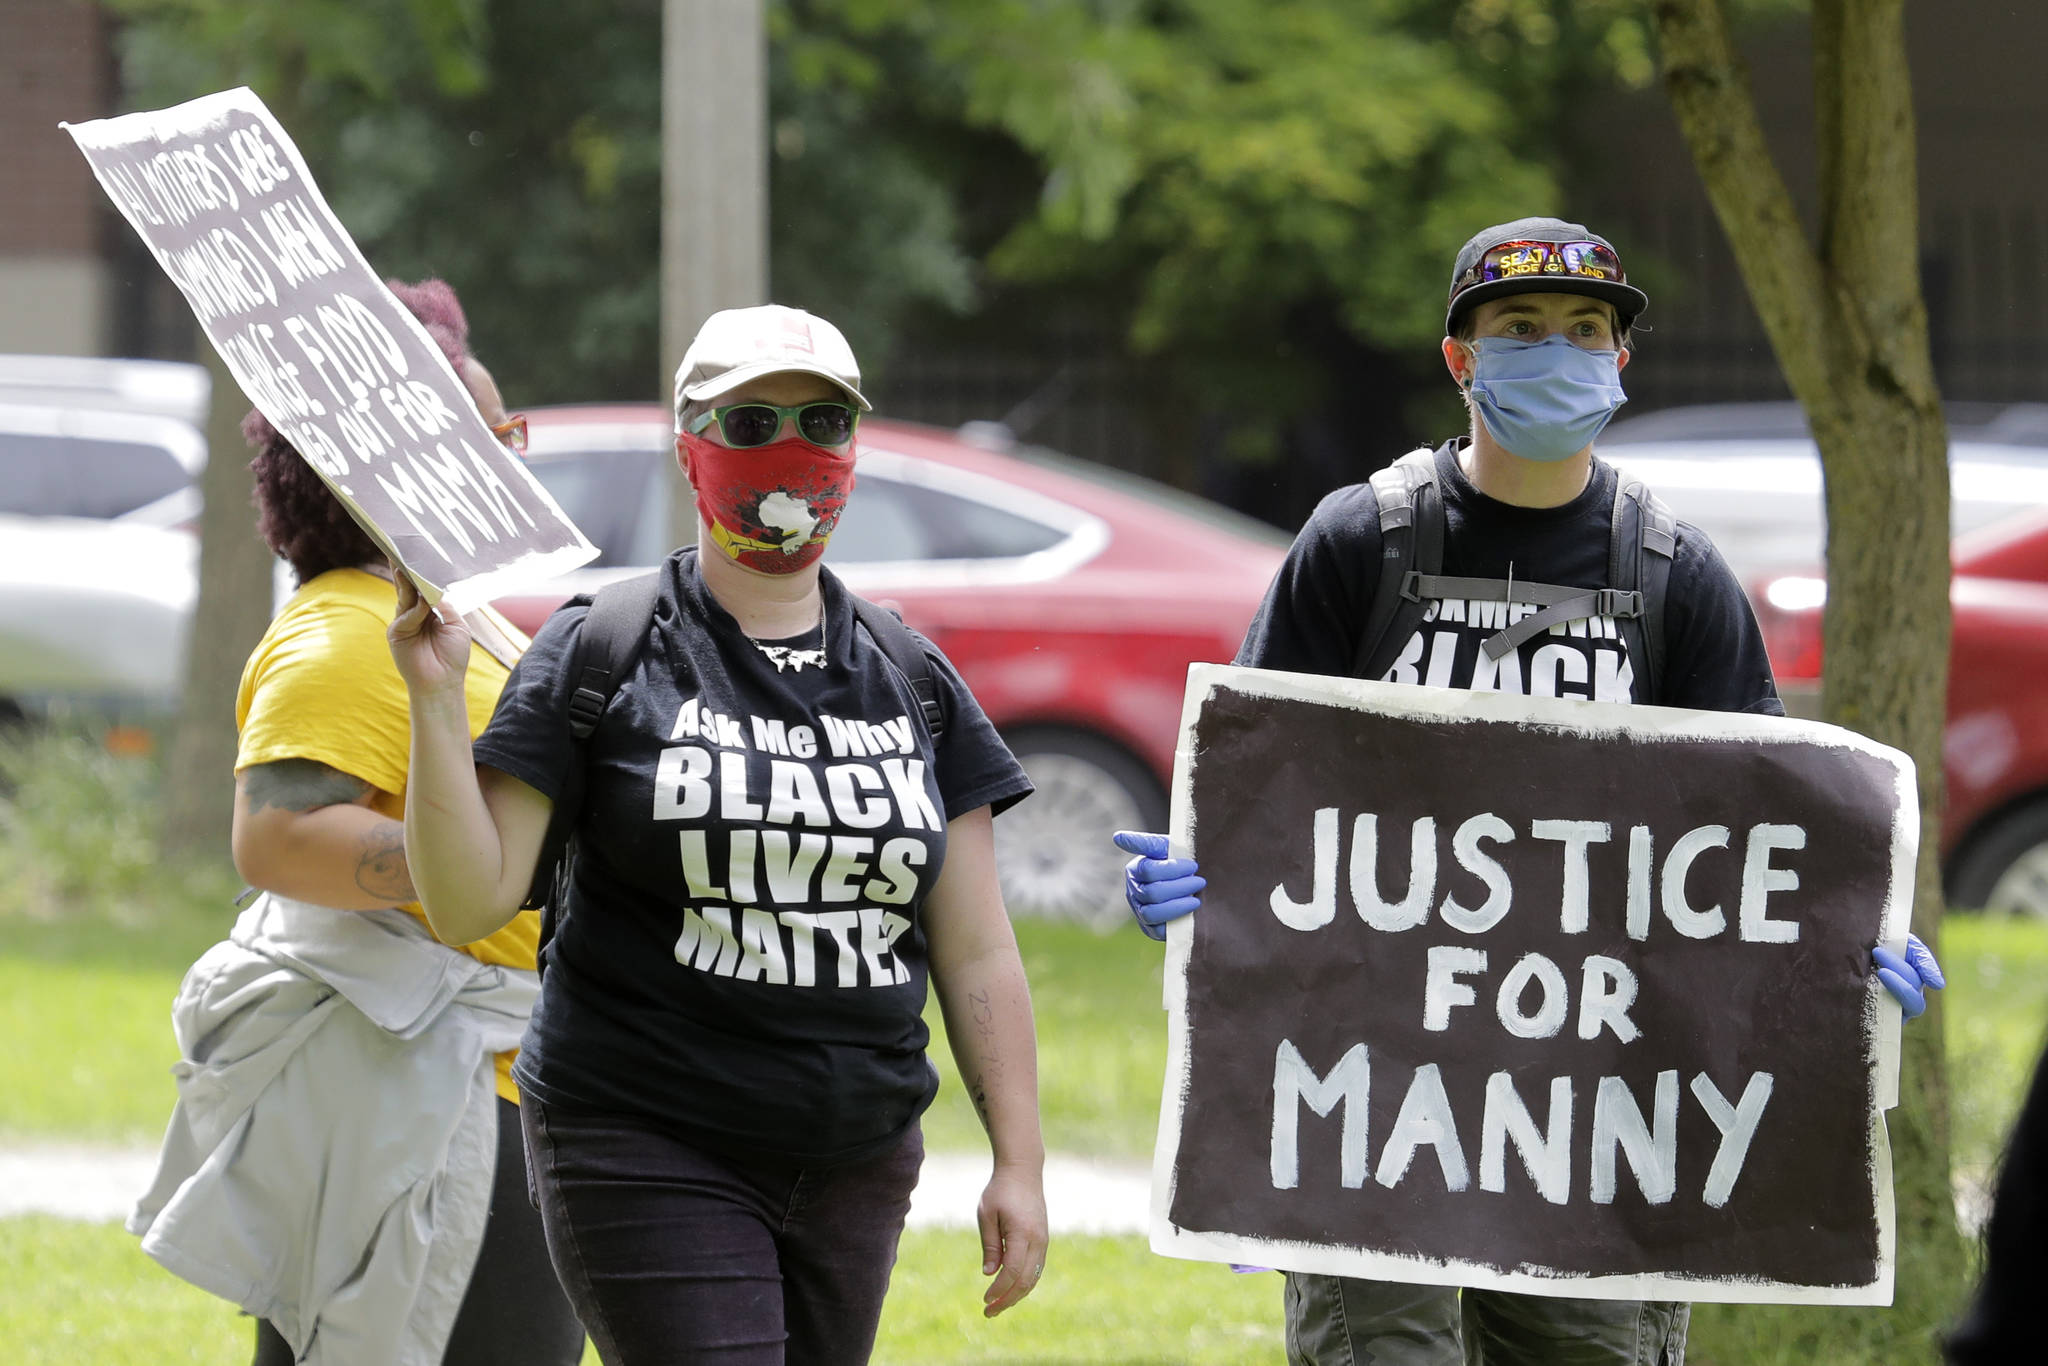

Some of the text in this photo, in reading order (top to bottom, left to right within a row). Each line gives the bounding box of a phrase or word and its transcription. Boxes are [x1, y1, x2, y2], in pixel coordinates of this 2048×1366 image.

[105, 124, 290, 229] ALL MOTHERS WERE
[160, 195, 346, 325] SUMMONED WHEN
[282, 292, 409, 407] FLOYD
[335, 398, 396, 464] OUT
[379, 380, 461, 443] FOR
[375, 437, 540, 565] MAMA
[670, 698, 915, 759] Ask Me Why
[653, 746, 943, 832] BLACK
[679, 829, 928, 905] LIVES
[1270, 807, 1806, 943] JUSTICE
[1423, 946, 1643, 1043] FOR
[1270, 1038, 1774, 1208] MANNY
